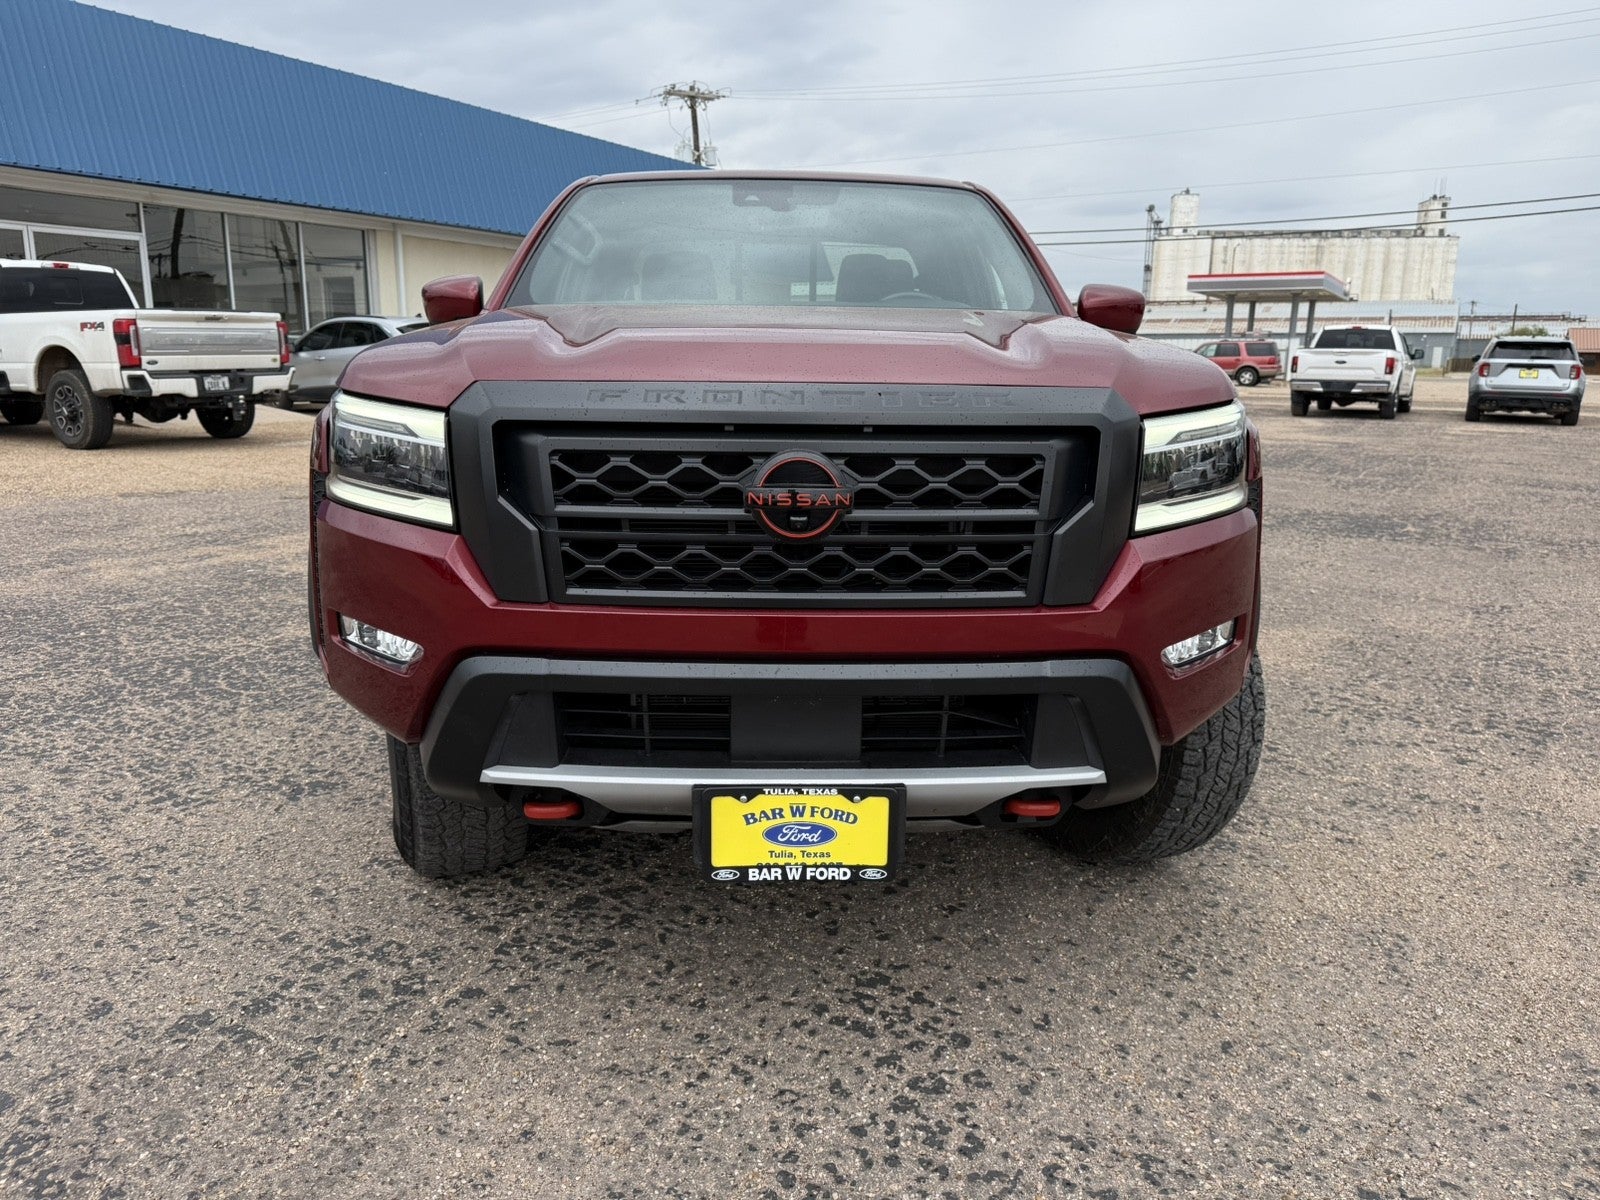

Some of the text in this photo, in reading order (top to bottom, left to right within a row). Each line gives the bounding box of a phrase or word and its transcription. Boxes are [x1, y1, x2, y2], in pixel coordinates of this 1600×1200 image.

[80, 321, 105, 331] FX4
[586, 388, 1012, 407] FRONTIER
[747, 492, 851, 506] NISSAN
[742, 803, 858, 826] BAR W FORD
[777, 825, 821, 842] Ford
[768, 850, 831, 859] Tulia, Texas
[748, 866, 851, 881] BAR W FORD
